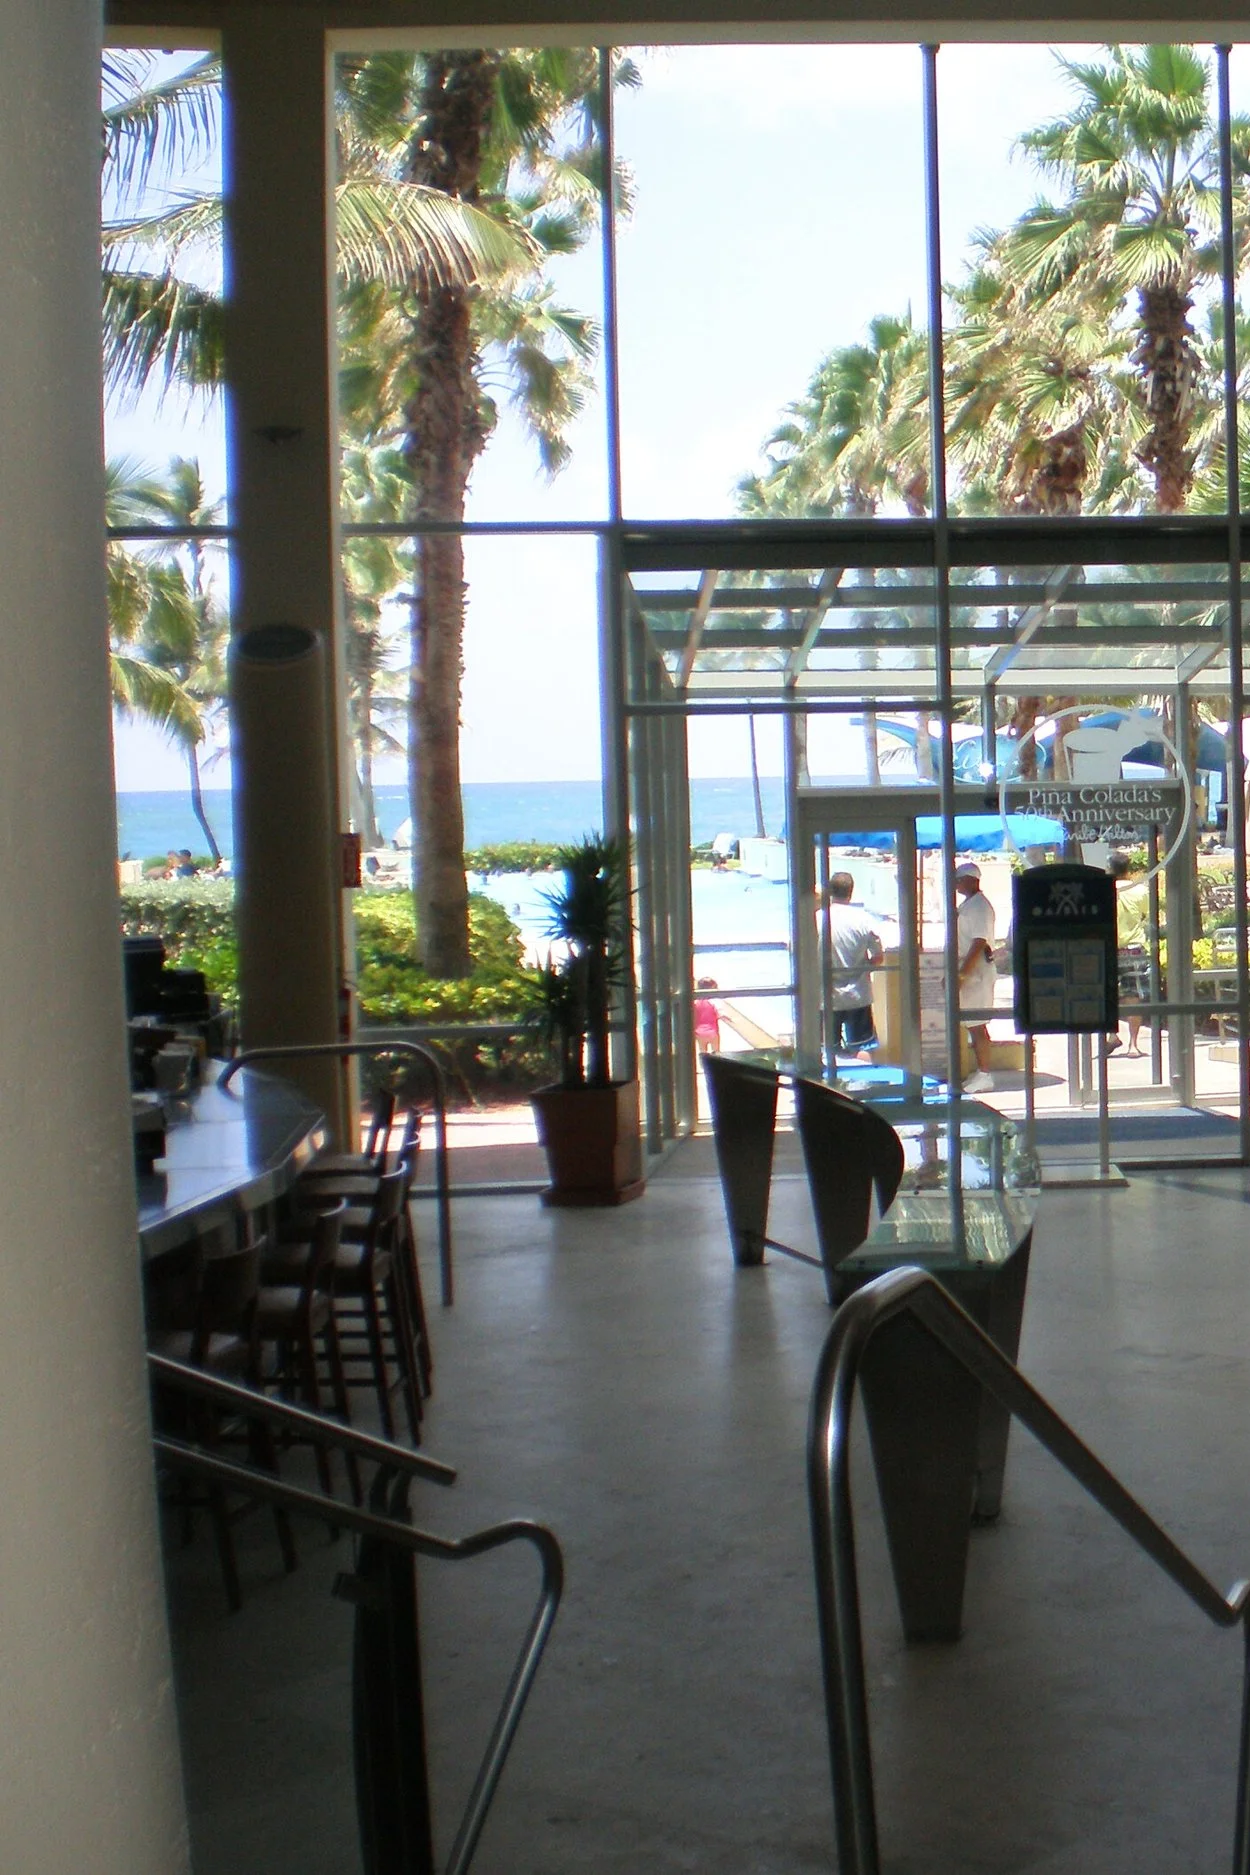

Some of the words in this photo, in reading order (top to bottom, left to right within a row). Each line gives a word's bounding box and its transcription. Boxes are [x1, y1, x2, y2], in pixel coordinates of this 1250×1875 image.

[1029, 788, 1072, 805] Piña
[1080, 785, 1162, 804] Colada's
[1061, 804, 1177, 826] Anniversary
